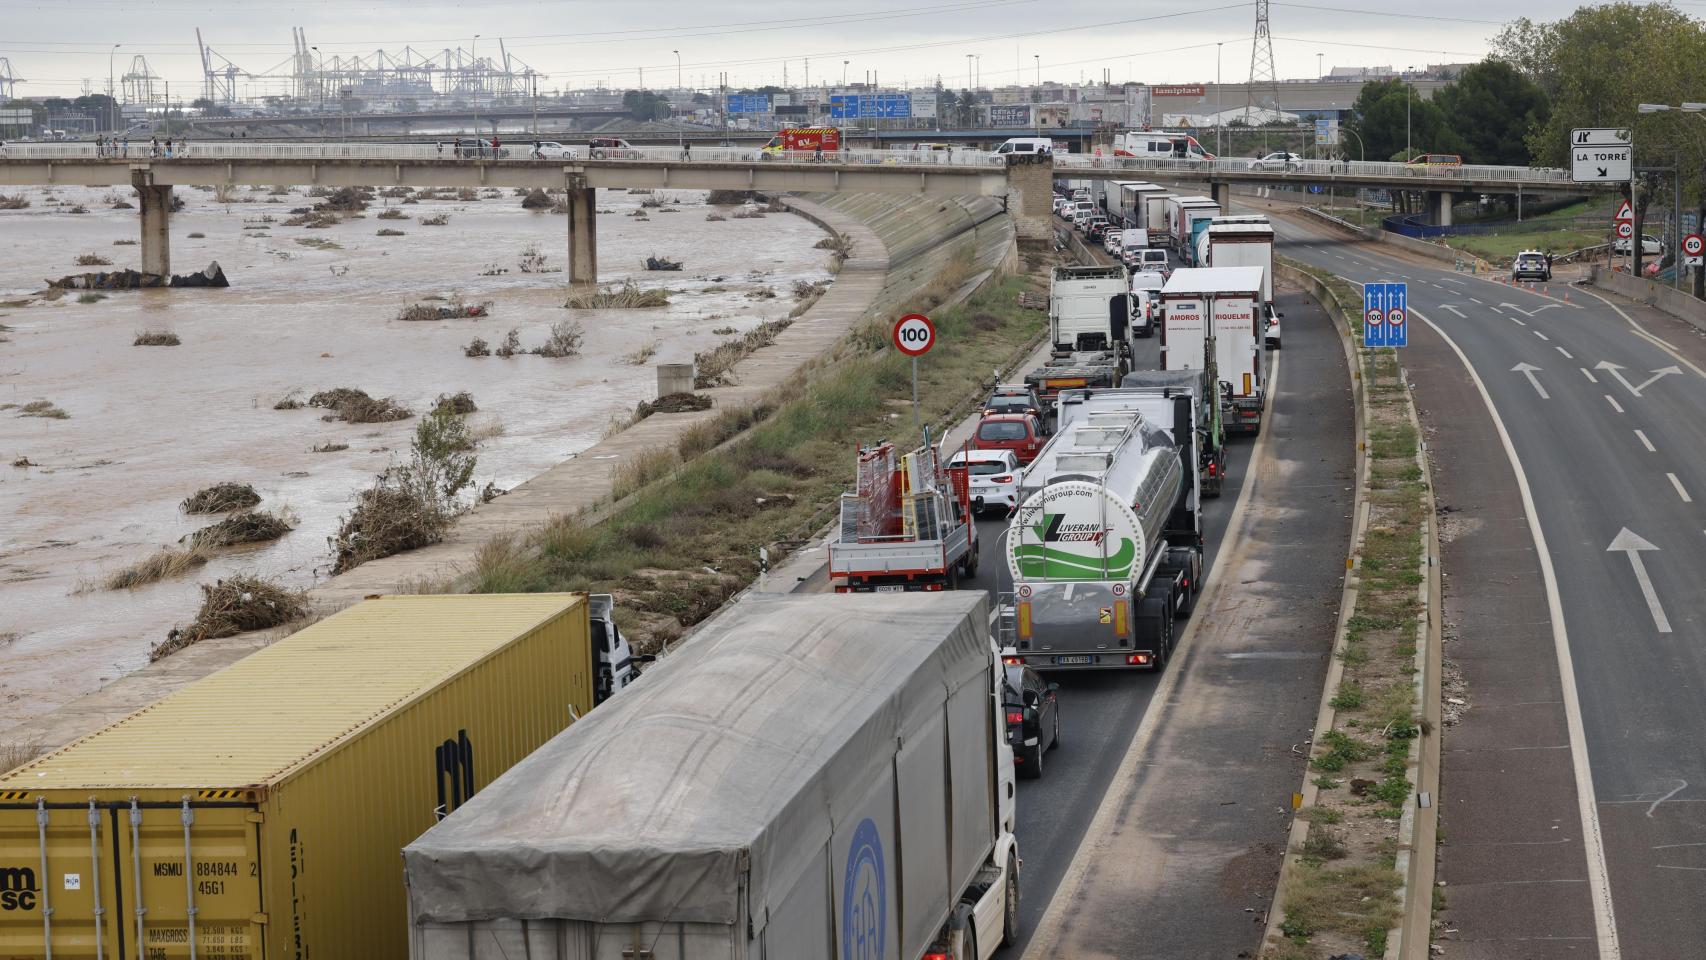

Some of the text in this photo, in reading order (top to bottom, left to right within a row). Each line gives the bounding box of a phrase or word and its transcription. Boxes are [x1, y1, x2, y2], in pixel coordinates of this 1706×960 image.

[1594, 153, 1627, 161] TORRE
[1687, 241, 1700, 249] 60
[901, 328, 928, 342] 100
[1059, 523, 1100, 532] LIVERANI
[1062, 533, 1093, 541] GROUP
[154, 862, 257, 877] MSMU 884844 2
[198, 881, 225, 895] 45G1
[149, 928, 188, 943] MAXGROSS
[230, 927, 244, 935] KGS
[230, 945, 243, 953] KGS
